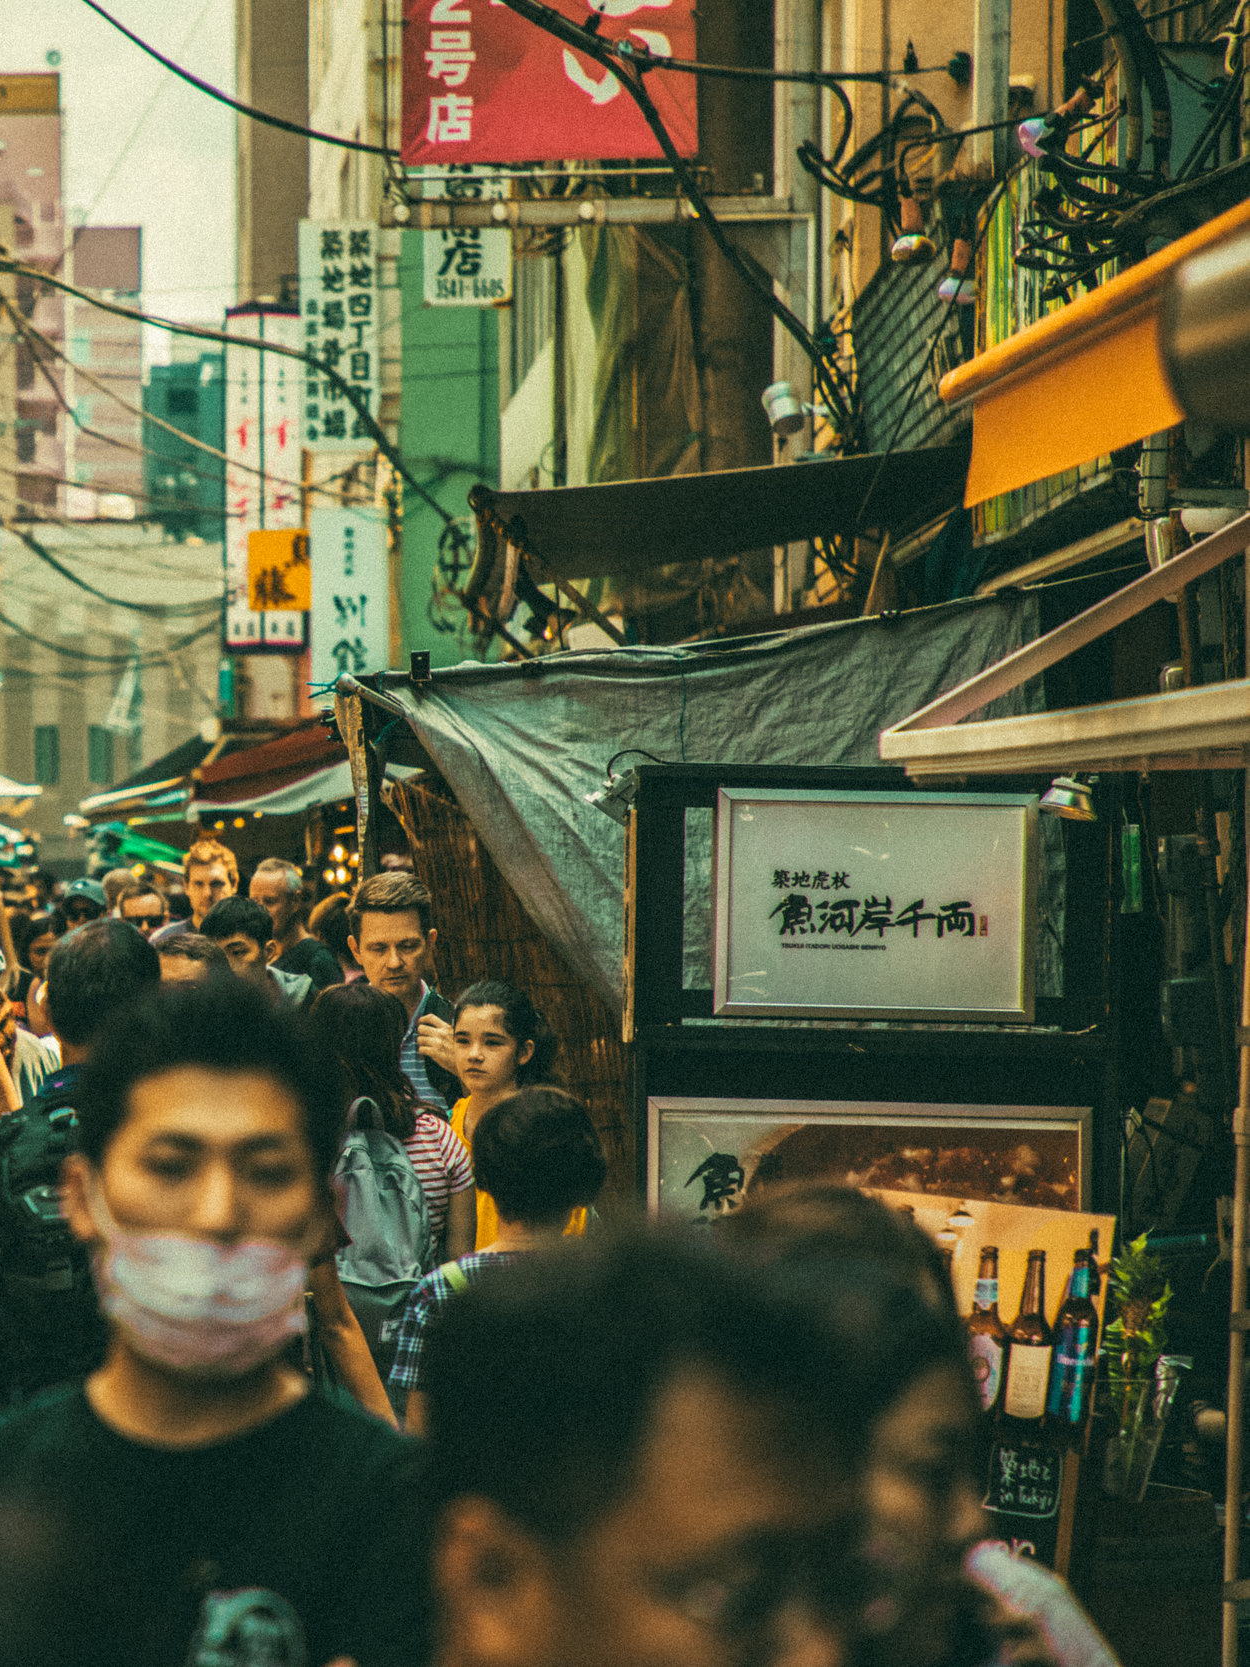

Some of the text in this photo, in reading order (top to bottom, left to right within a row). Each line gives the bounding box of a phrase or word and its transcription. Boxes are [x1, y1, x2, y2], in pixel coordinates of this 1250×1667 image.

[771, 869, 851, 890] 築地虎杖
[769, 893, 976, 938] 魚河岸千両
